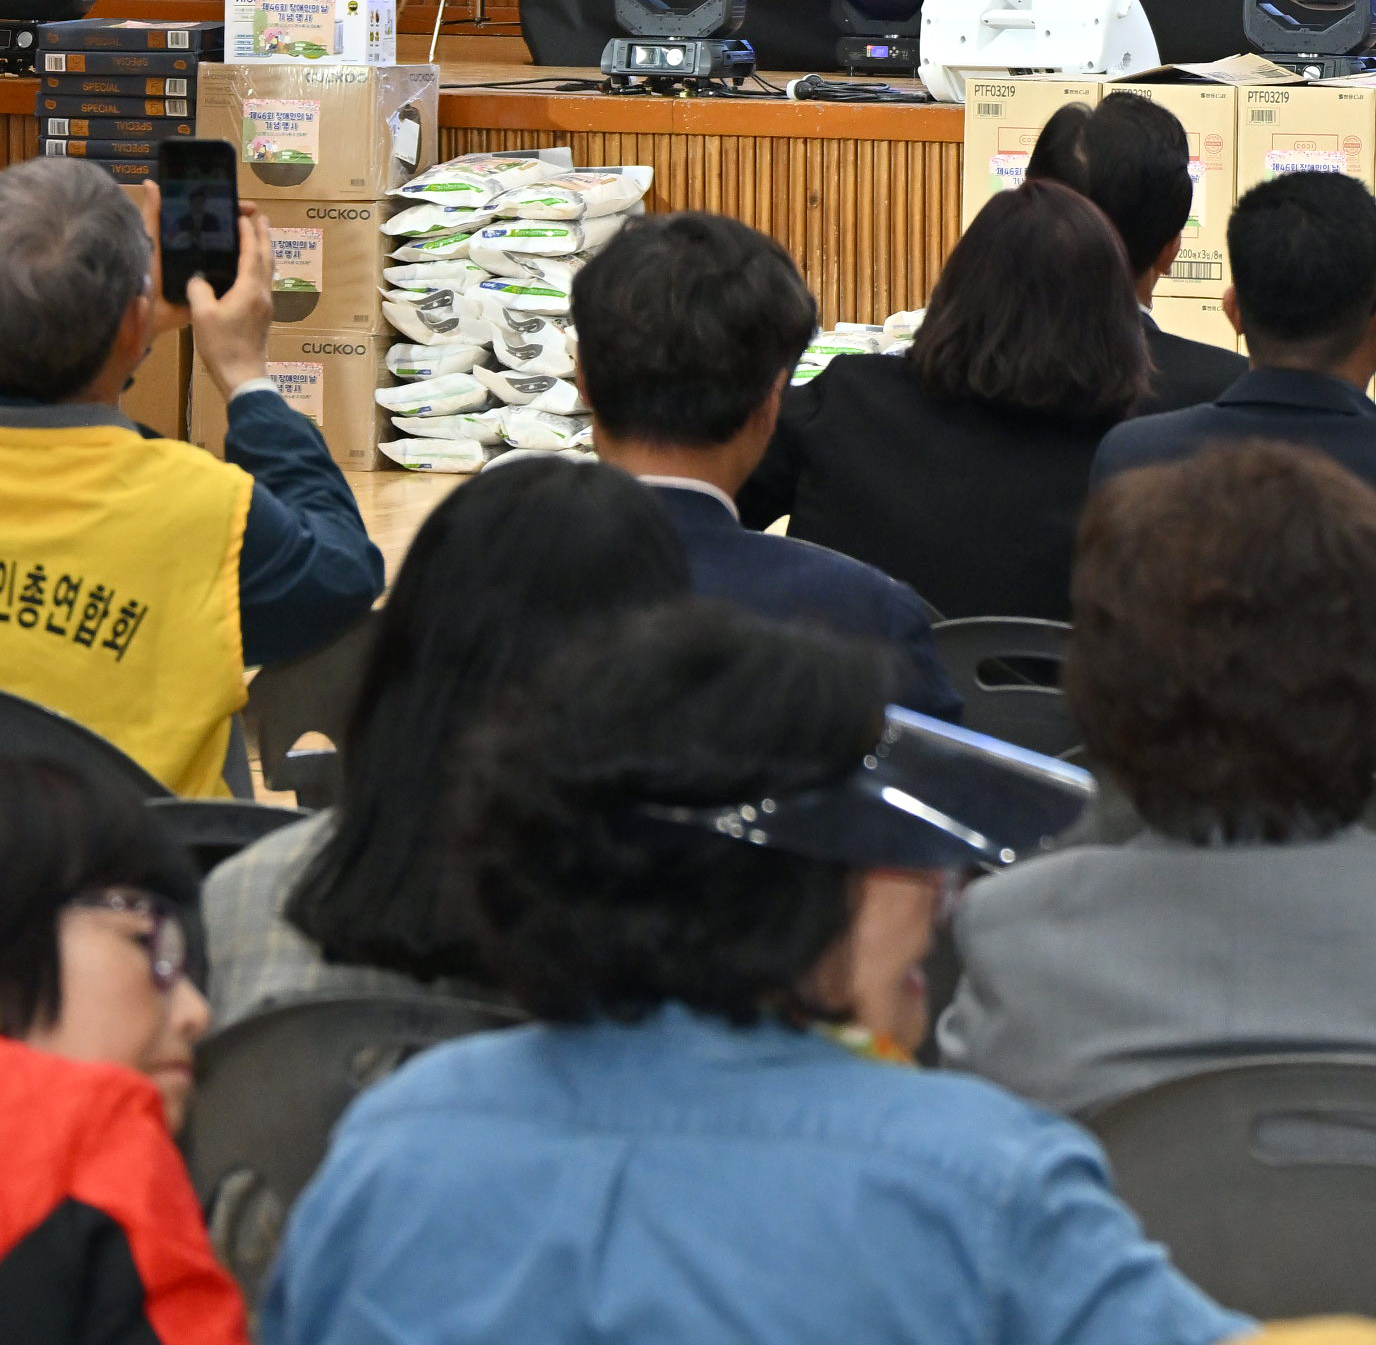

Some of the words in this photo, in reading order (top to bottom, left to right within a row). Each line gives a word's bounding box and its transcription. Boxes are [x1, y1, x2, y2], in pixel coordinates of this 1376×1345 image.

[82, 82, 121, 93] SPECIAL
[974, 84, 1016, 98] PTF03219
[1248, 91, 1290, 104] PTF03219
[81, 103, 121, 114] SPECIAL
[114, 121, 152, 131] SPECIAL
[112, 143, 150, 153] SPECIAL
[112, 165, 149, 175] SPECIAL
[306, 208, 371, 220] CUCKOO
[301, 343, 367, 355] CUCKOO
